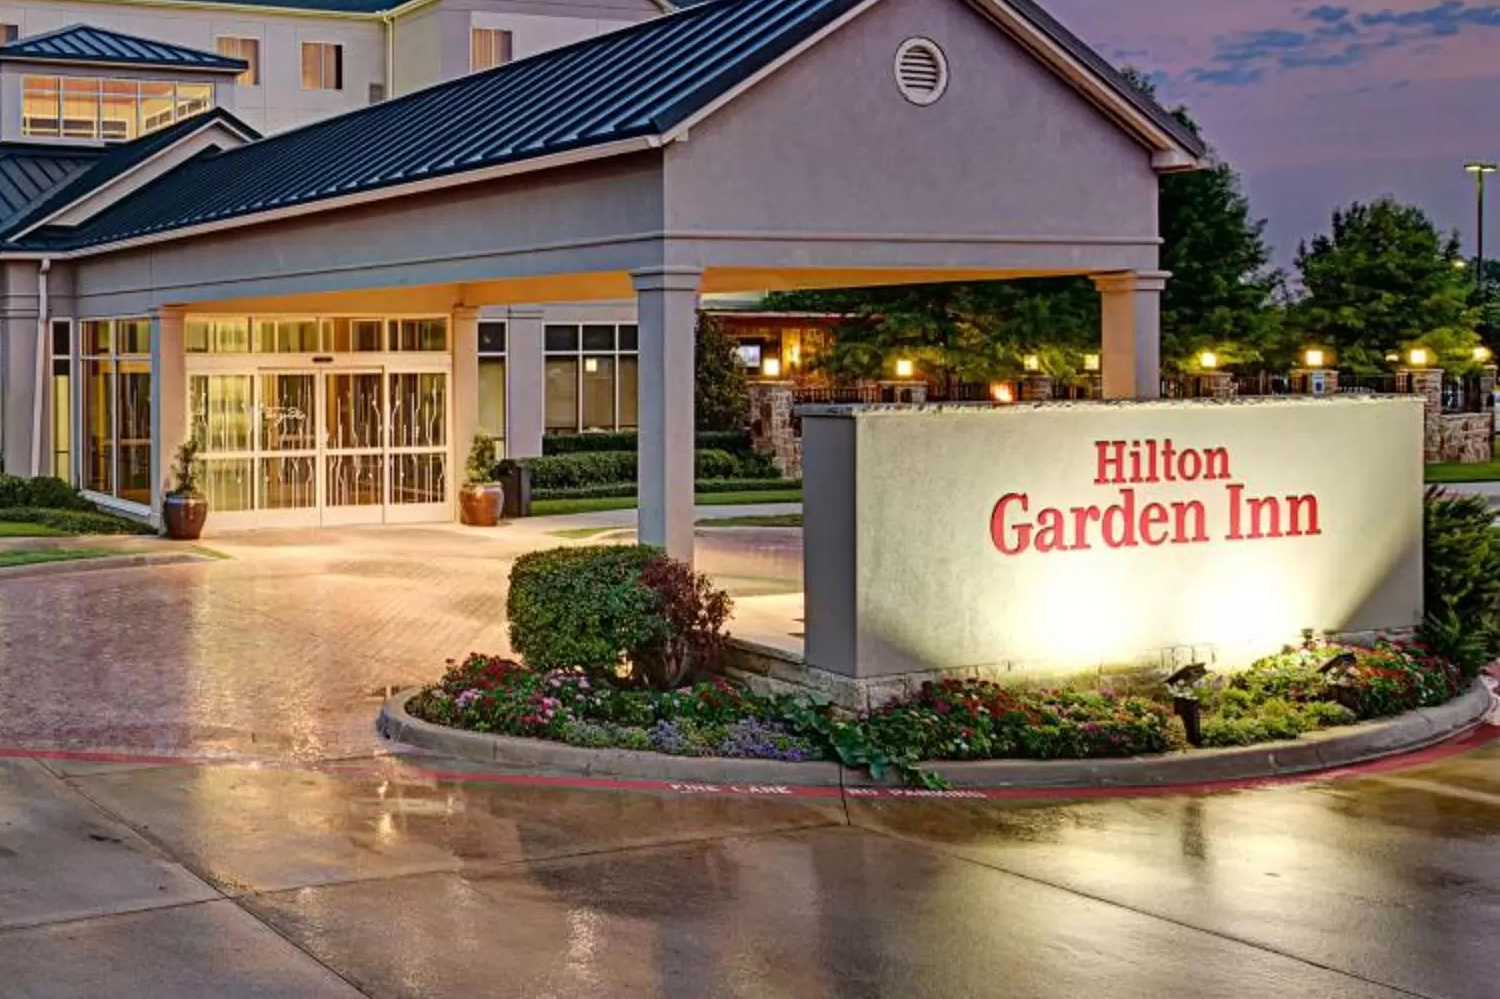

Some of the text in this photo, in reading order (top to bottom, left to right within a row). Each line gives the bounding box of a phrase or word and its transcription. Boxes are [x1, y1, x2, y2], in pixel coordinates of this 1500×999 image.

[1094, 439, 1232, 484] Hilton
[989, 484, 1322, 555] Garden Inn
